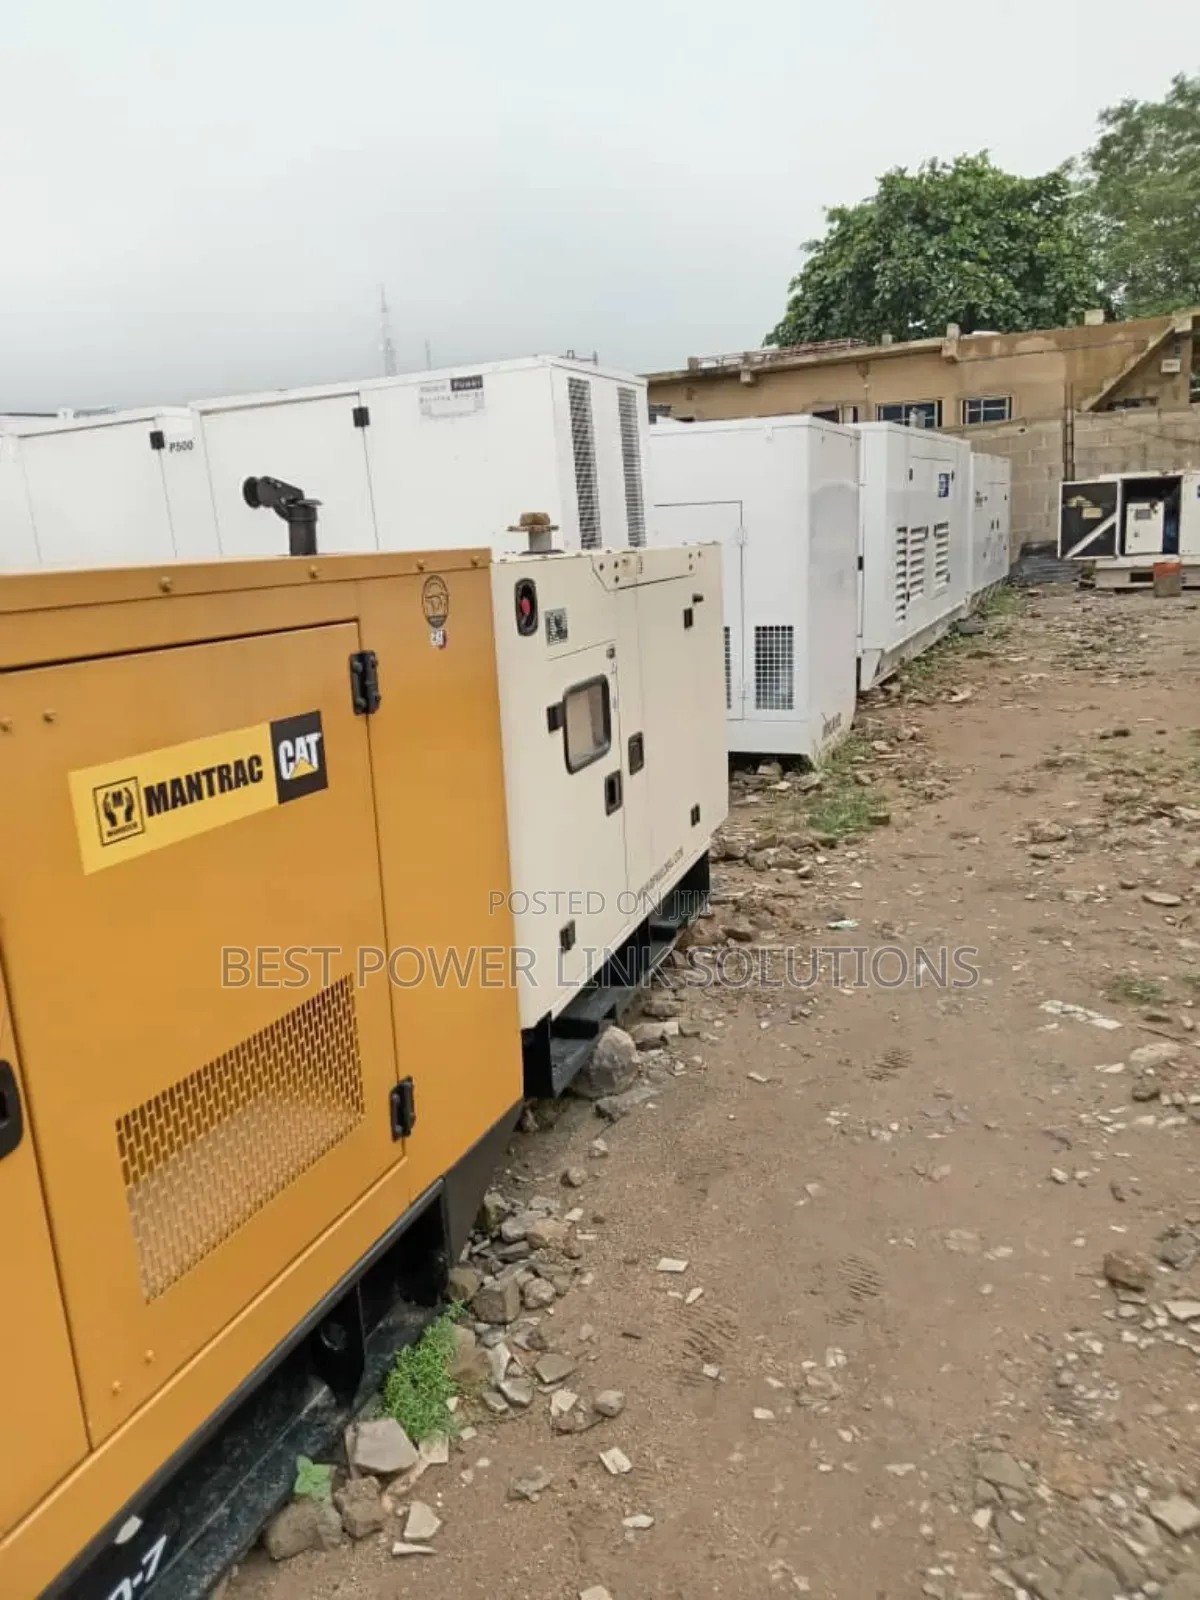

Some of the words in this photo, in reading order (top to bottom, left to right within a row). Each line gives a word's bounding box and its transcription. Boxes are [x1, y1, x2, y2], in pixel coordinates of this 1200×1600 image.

[169, 440, 193, 453] P500
[278, 732, 321, 780] CAT
[144, 754, 264, 817] MANTRAC
